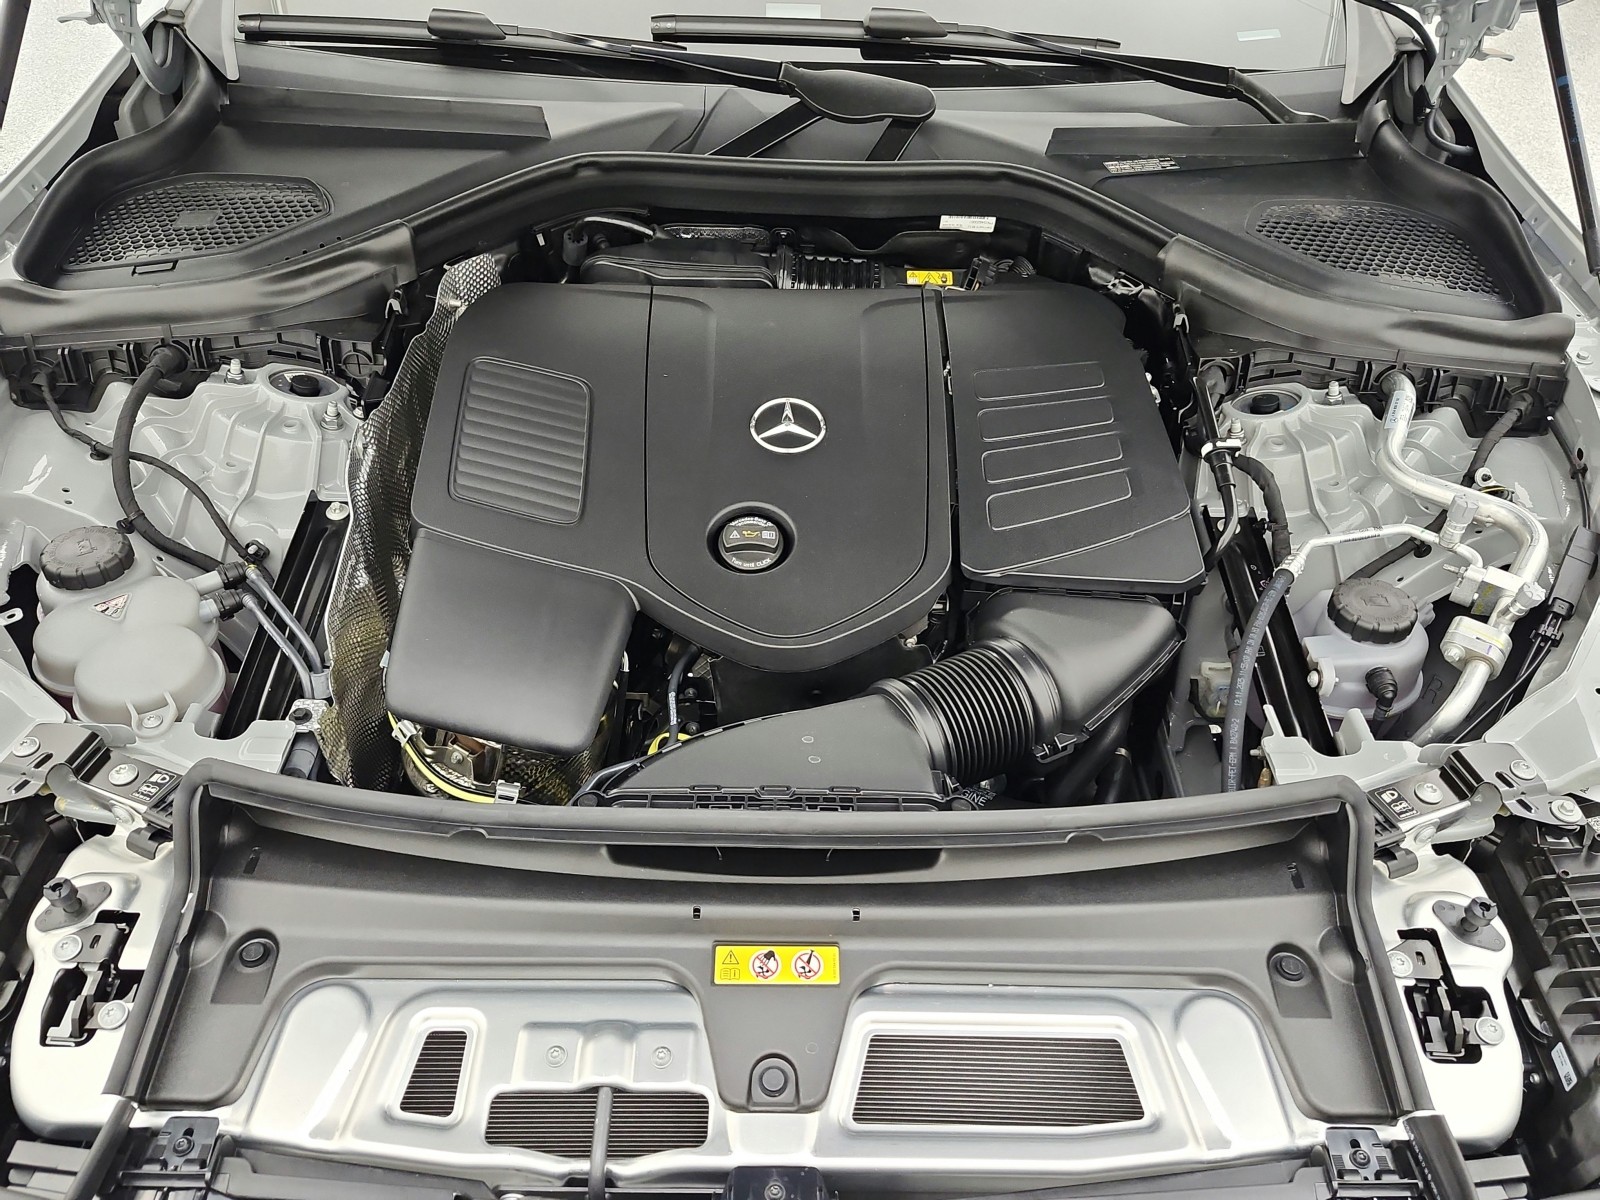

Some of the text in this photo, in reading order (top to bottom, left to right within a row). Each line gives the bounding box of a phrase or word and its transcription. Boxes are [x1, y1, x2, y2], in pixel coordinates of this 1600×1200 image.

[732, 557, 742, 566] Turn
[756, 558, 772, 566] CLICK
[962, 790, 987, 806] GINE
